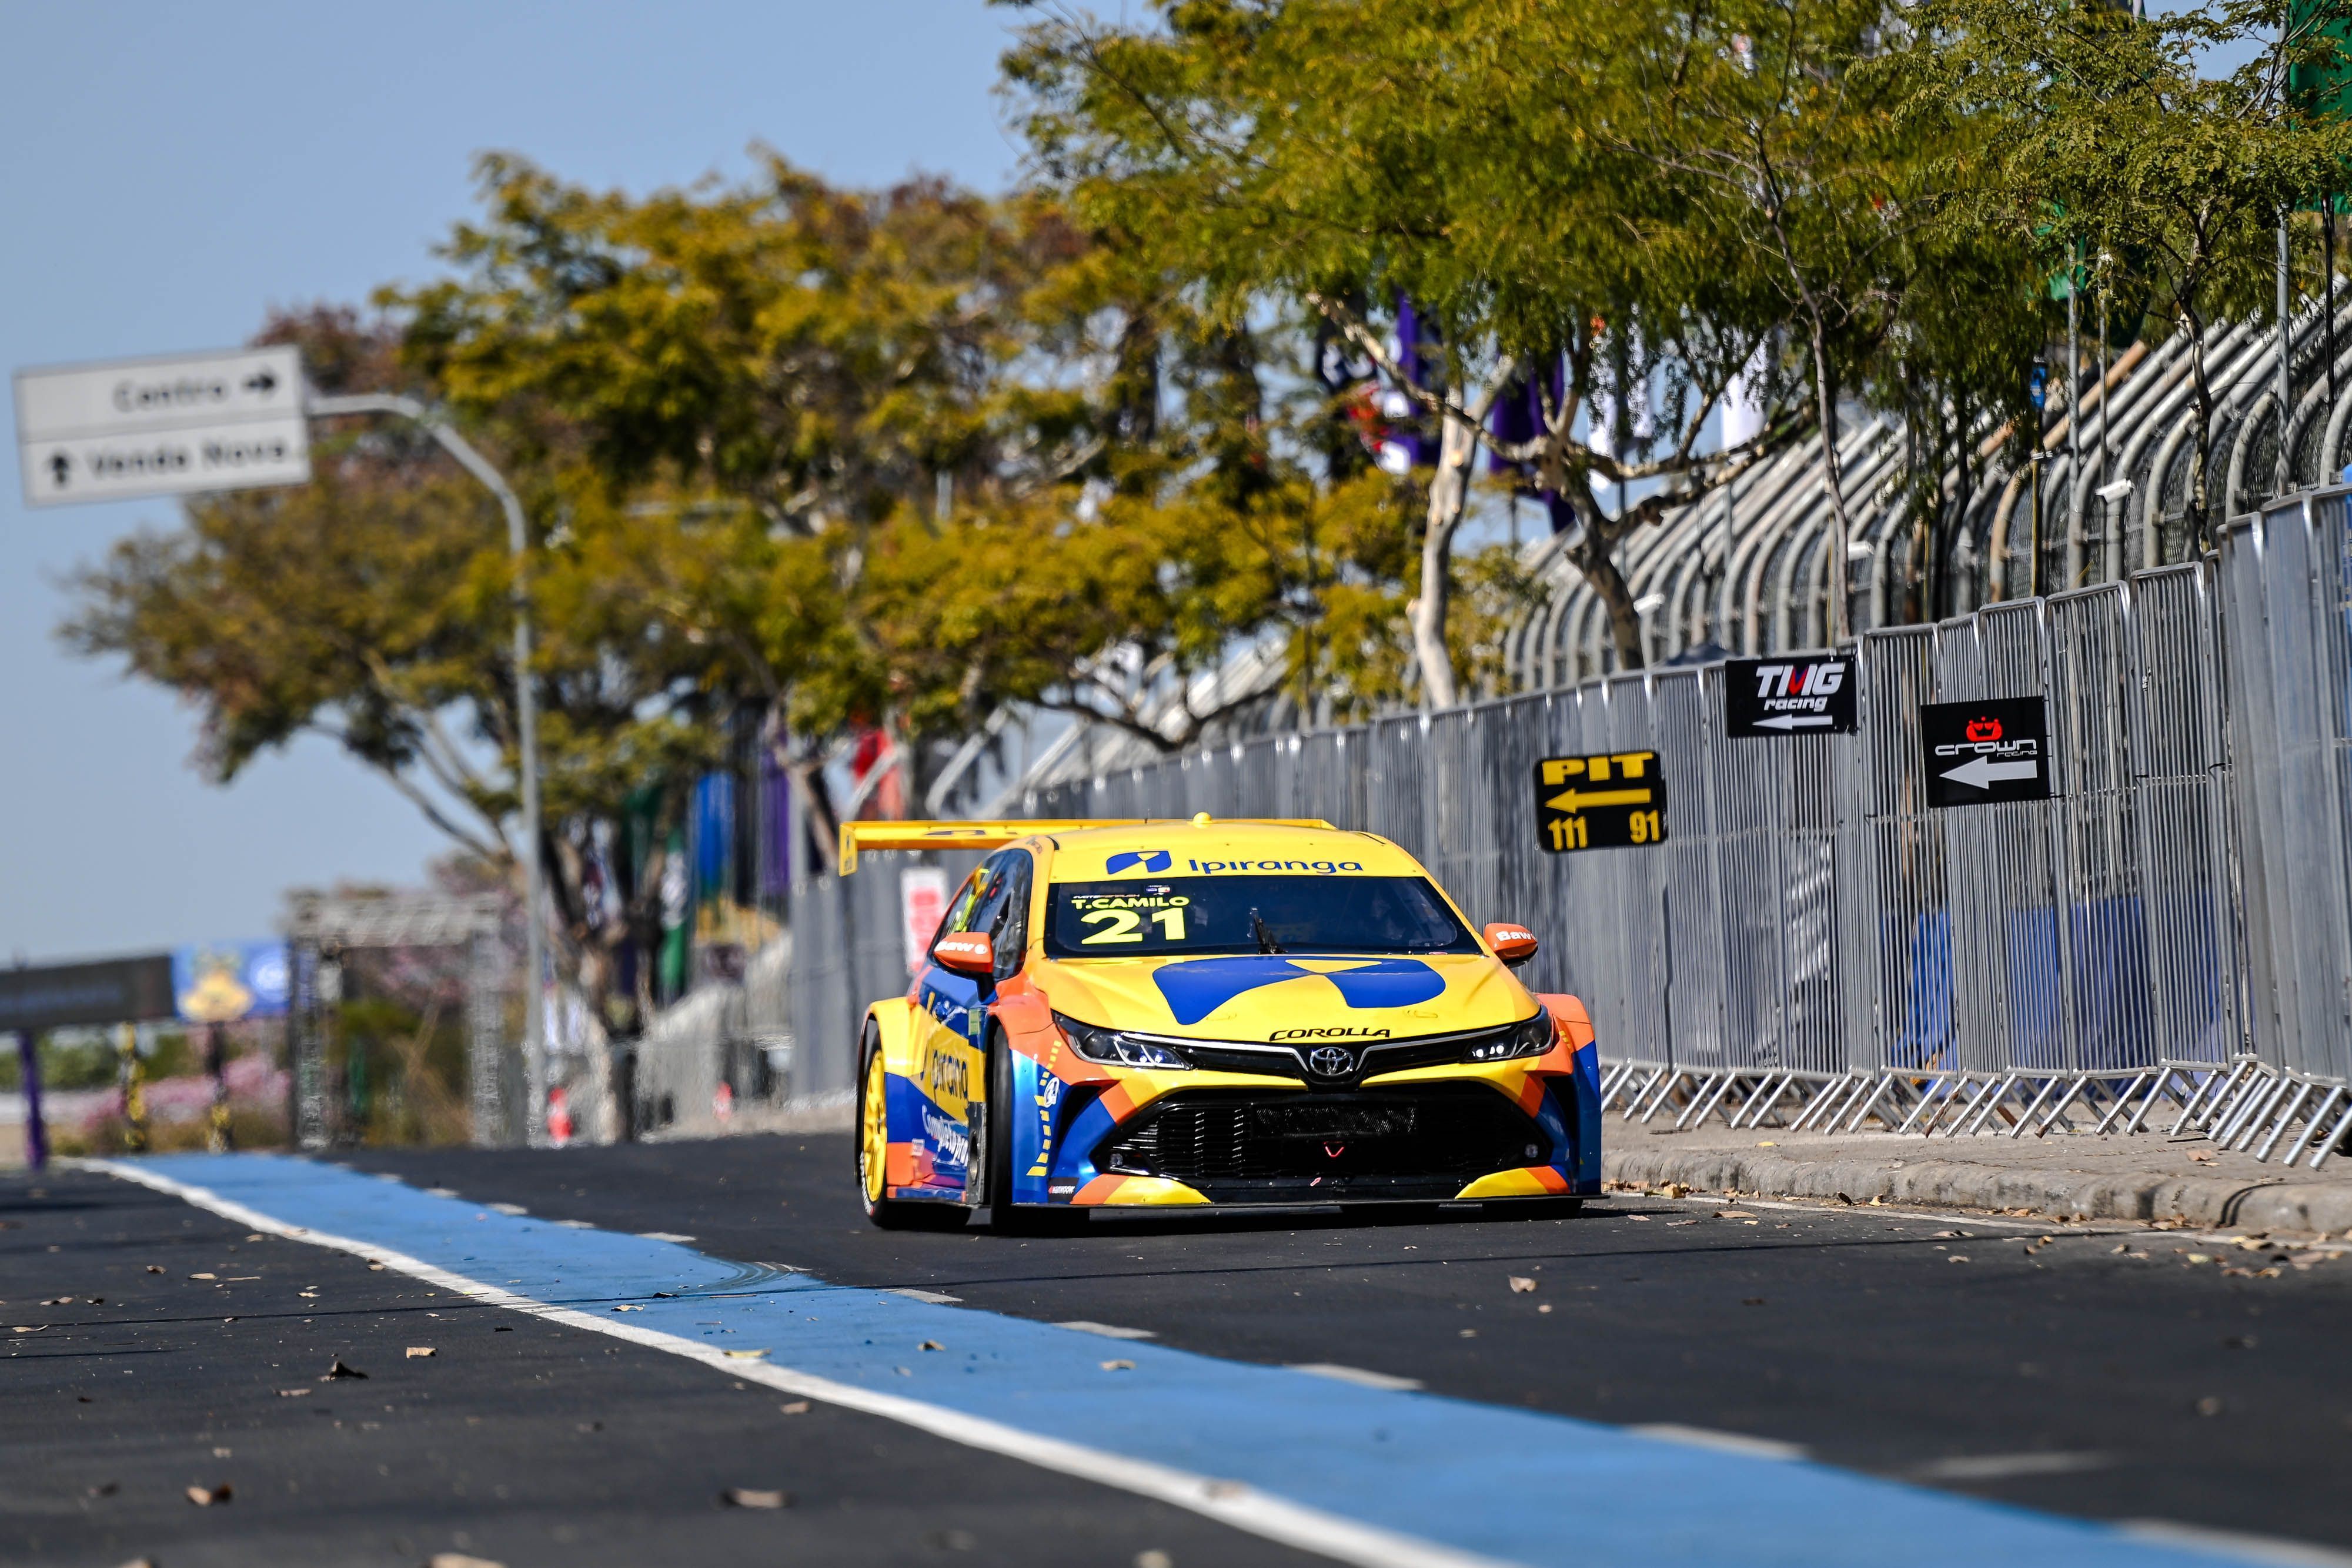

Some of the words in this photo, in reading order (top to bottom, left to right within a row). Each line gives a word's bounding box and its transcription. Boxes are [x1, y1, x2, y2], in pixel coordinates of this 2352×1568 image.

[114, 380, 228, 412] Centro
[88, 446, 191, 479] Venda
[201, 439, 287, 470] Nova
[1756, 661, 1846, 698] TMG
[1764, 696, 1828, 712] racing
[1935, 739, 2037, 756] crown
[1542, 752, 1654, 785] PIT
[1548, 815, 1587, 851] 111
[1629, 809, 1660, 844] 91
[1188, 859, 1364, 875] Ipiranga
[1071, 896, 1190, 910] T.CAMILO
[1080, 907, 1186, 945] 21
[1269, 1027, 1390, 1042] COROLLA
